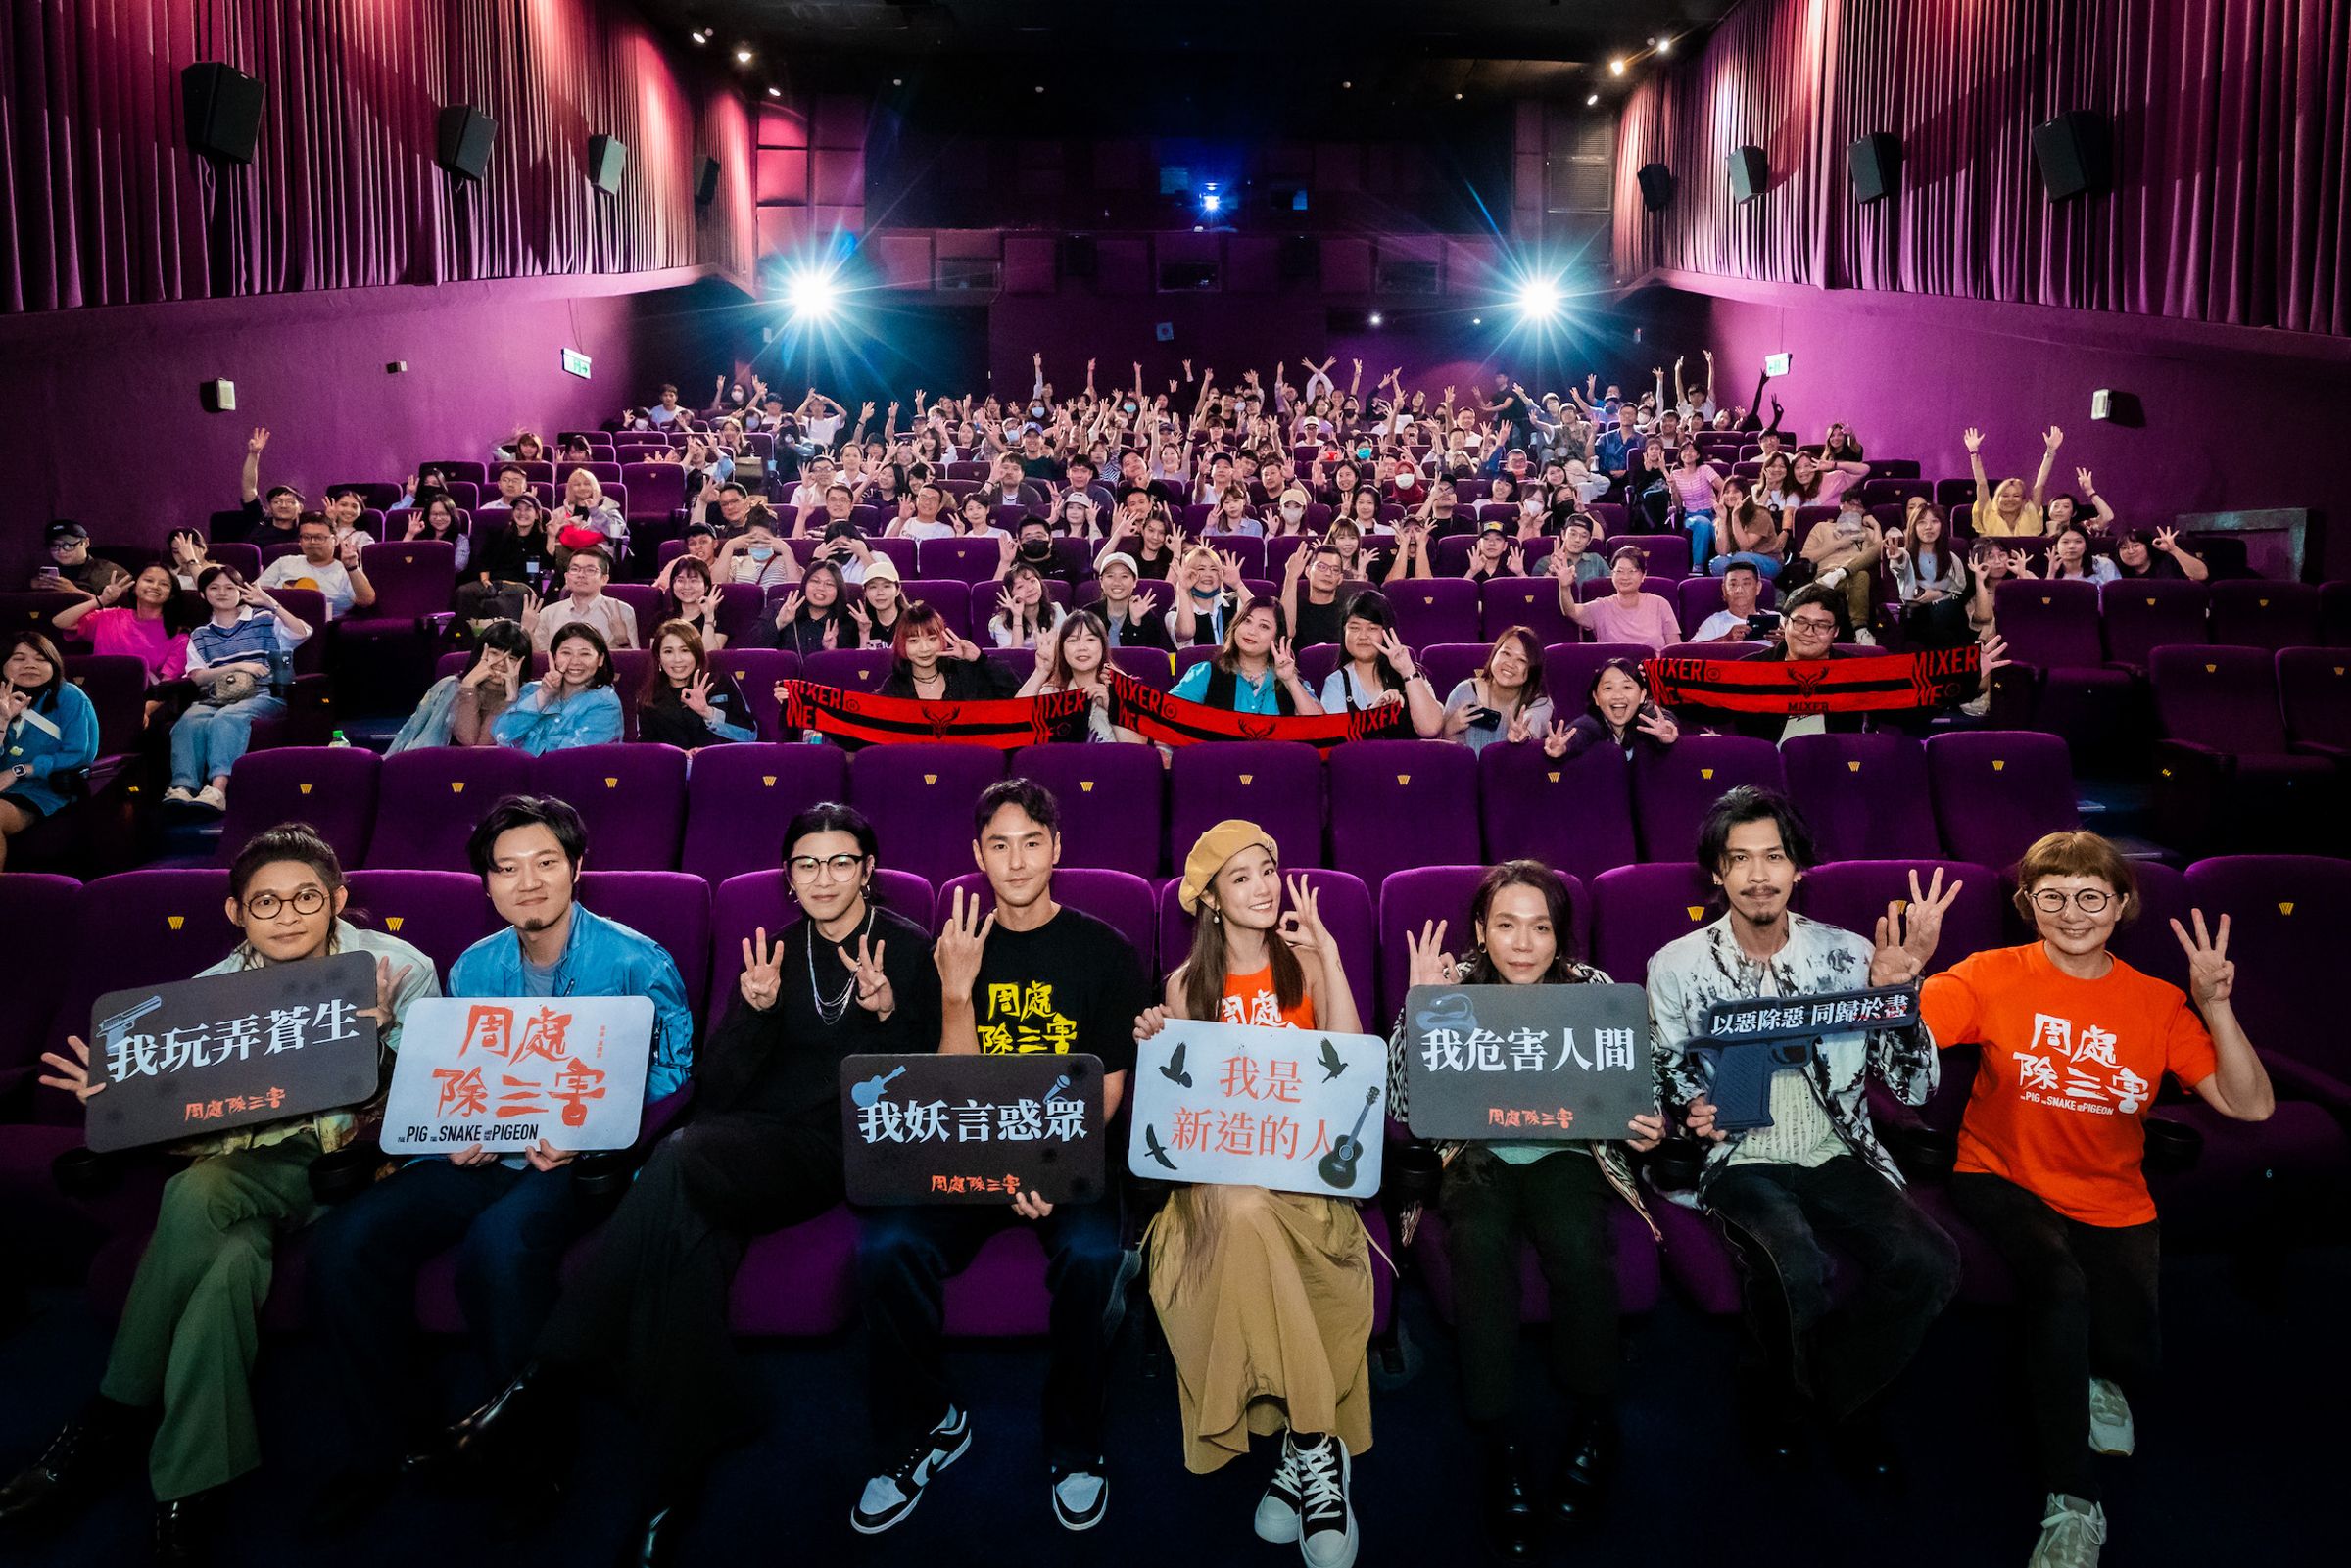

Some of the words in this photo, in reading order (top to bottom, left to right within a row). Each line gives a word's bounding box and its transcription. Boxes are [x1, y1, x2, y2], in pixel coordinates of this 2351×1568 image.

[1644, 658, 1703, 682] MIXER
[1912, 646, 1979, 677] MIXER
[784, 680, 842, 710] MIXER
[1032, 688, 1086, 719] MIXER
[1788, 701, 1829, 713] MIXER
[1348, 701, 1402, 734] MIXER
[987, 980, 1057, 1022] 周處
[1711, 1006, 1805, 1035] 以惡除惡
[1811, 995, 1909, 1026] 同歸於盡
[106, 998, 360, 1083] 我玩弄蒼生
[458, 1005, 573, 1066] 周處
[978, 1013, 1078, 1055] 除三害
[1421, 1027, 1635, 1072] 我危害人間
[2030, 1013, 2124, 1069] 周處
[432, 1058, 606, 1127] 除三害
[1219, 1056, 1303, 1103] 我是
[2013, 1051, 2149, 1114] 除三害
[184, 1086, 286, 1121] 周處除三害
[857, 1098, 1087, 1143] 我妖言惑眾
[1488, 1107, 1573, 1129] 周處除三害
[2025, 1092, 2040, 1103] PIG
[2046, 1096, 2077, 1111] SNAKE
[2082, 1103, 2114, 1115] PIGEON
[407, 1125, 428, 1143] PIG
[439, 1125, 483, 1142] SNAKE
[492, 1123, 539, 1141] PIGEON
[1171, 1106, 1334, 1161] 新造的人
[931, 1173, 1021, 1195] 周處除三害
[2266, 1168, 2273, 1179] 6
